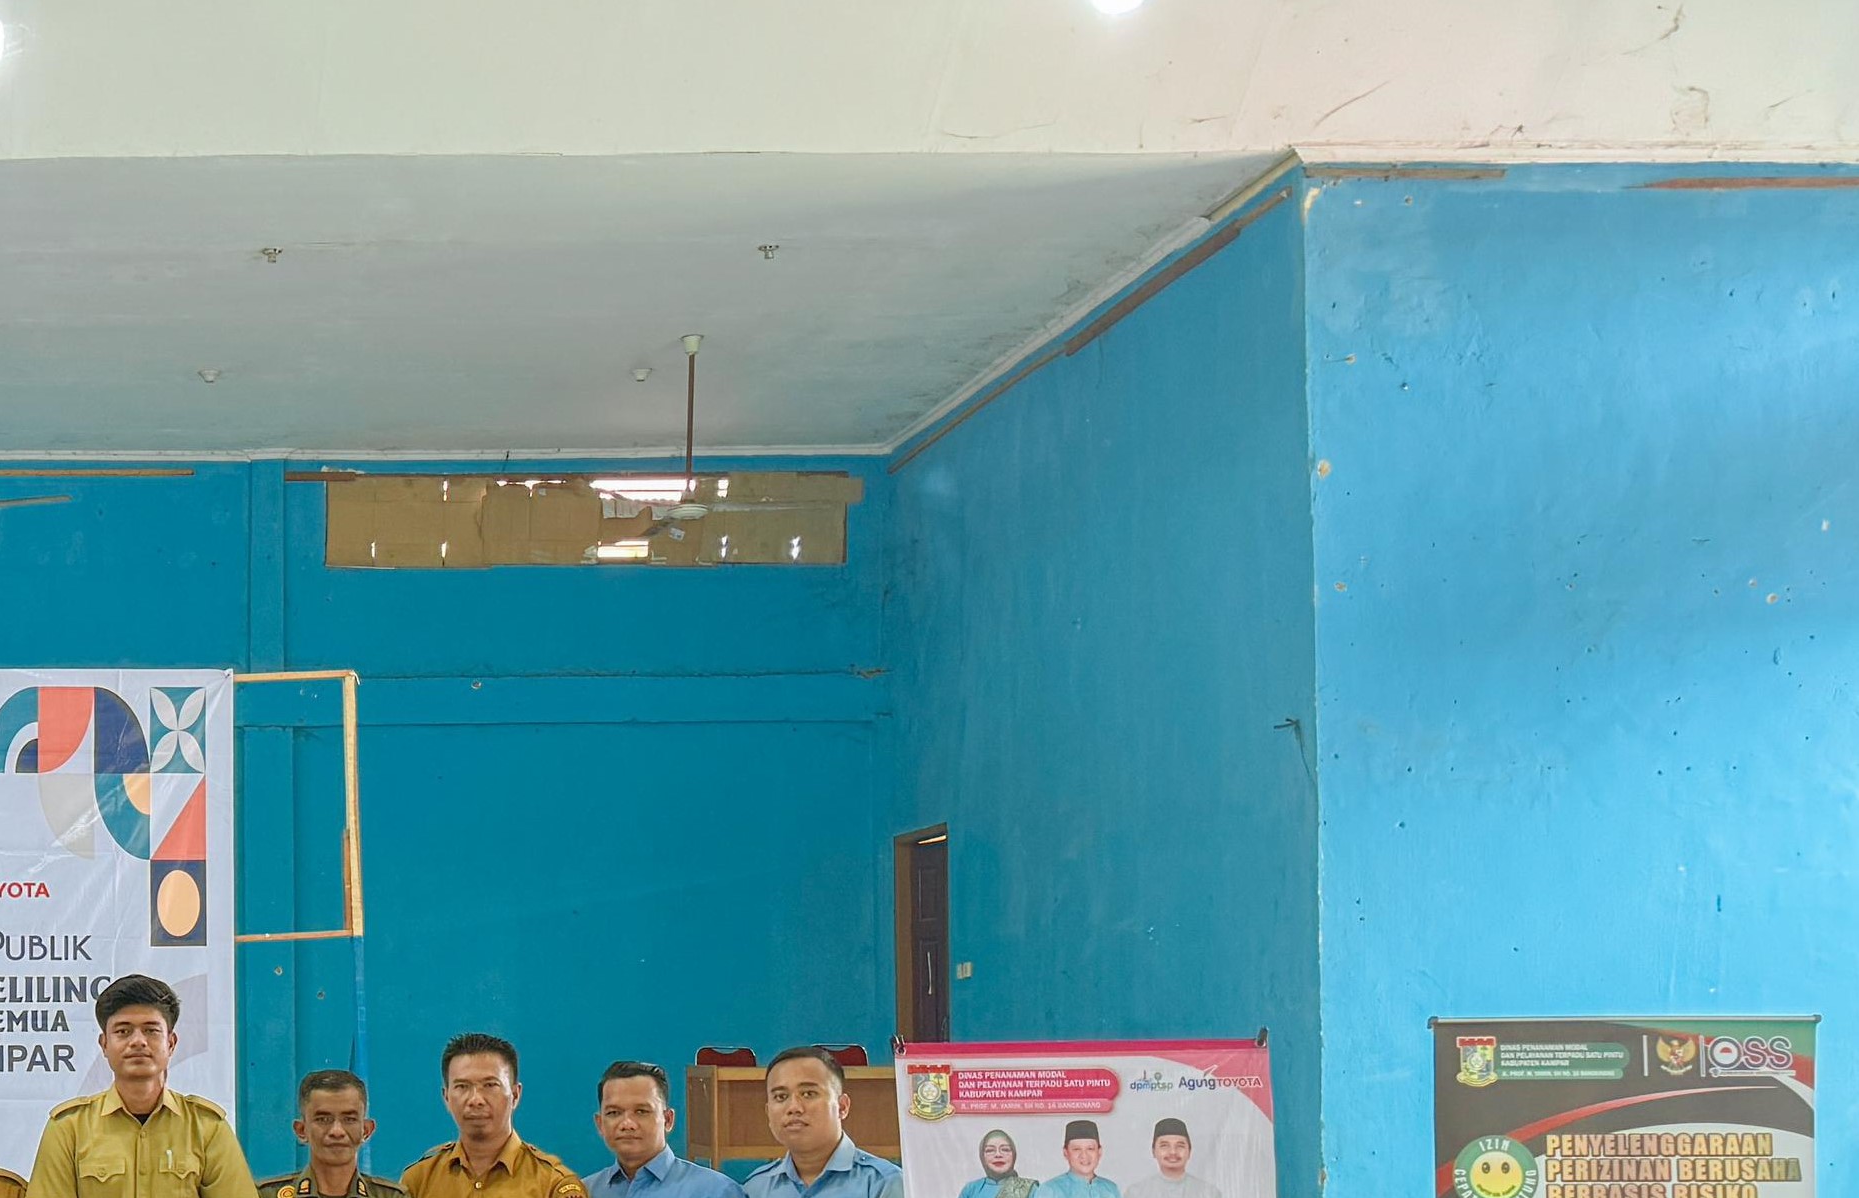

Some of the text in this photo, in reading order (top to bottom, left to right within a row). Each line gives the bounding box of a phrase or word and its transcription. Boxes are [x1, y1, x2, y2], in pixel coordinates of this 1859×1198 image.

[1707, 1035, 1792, 1070] OSS
[1544, 1133, 1772, 1156] PENYELENGGARAAN
[1545, 1159, 1802, 1182] PERIZINAN BERUSAHA
